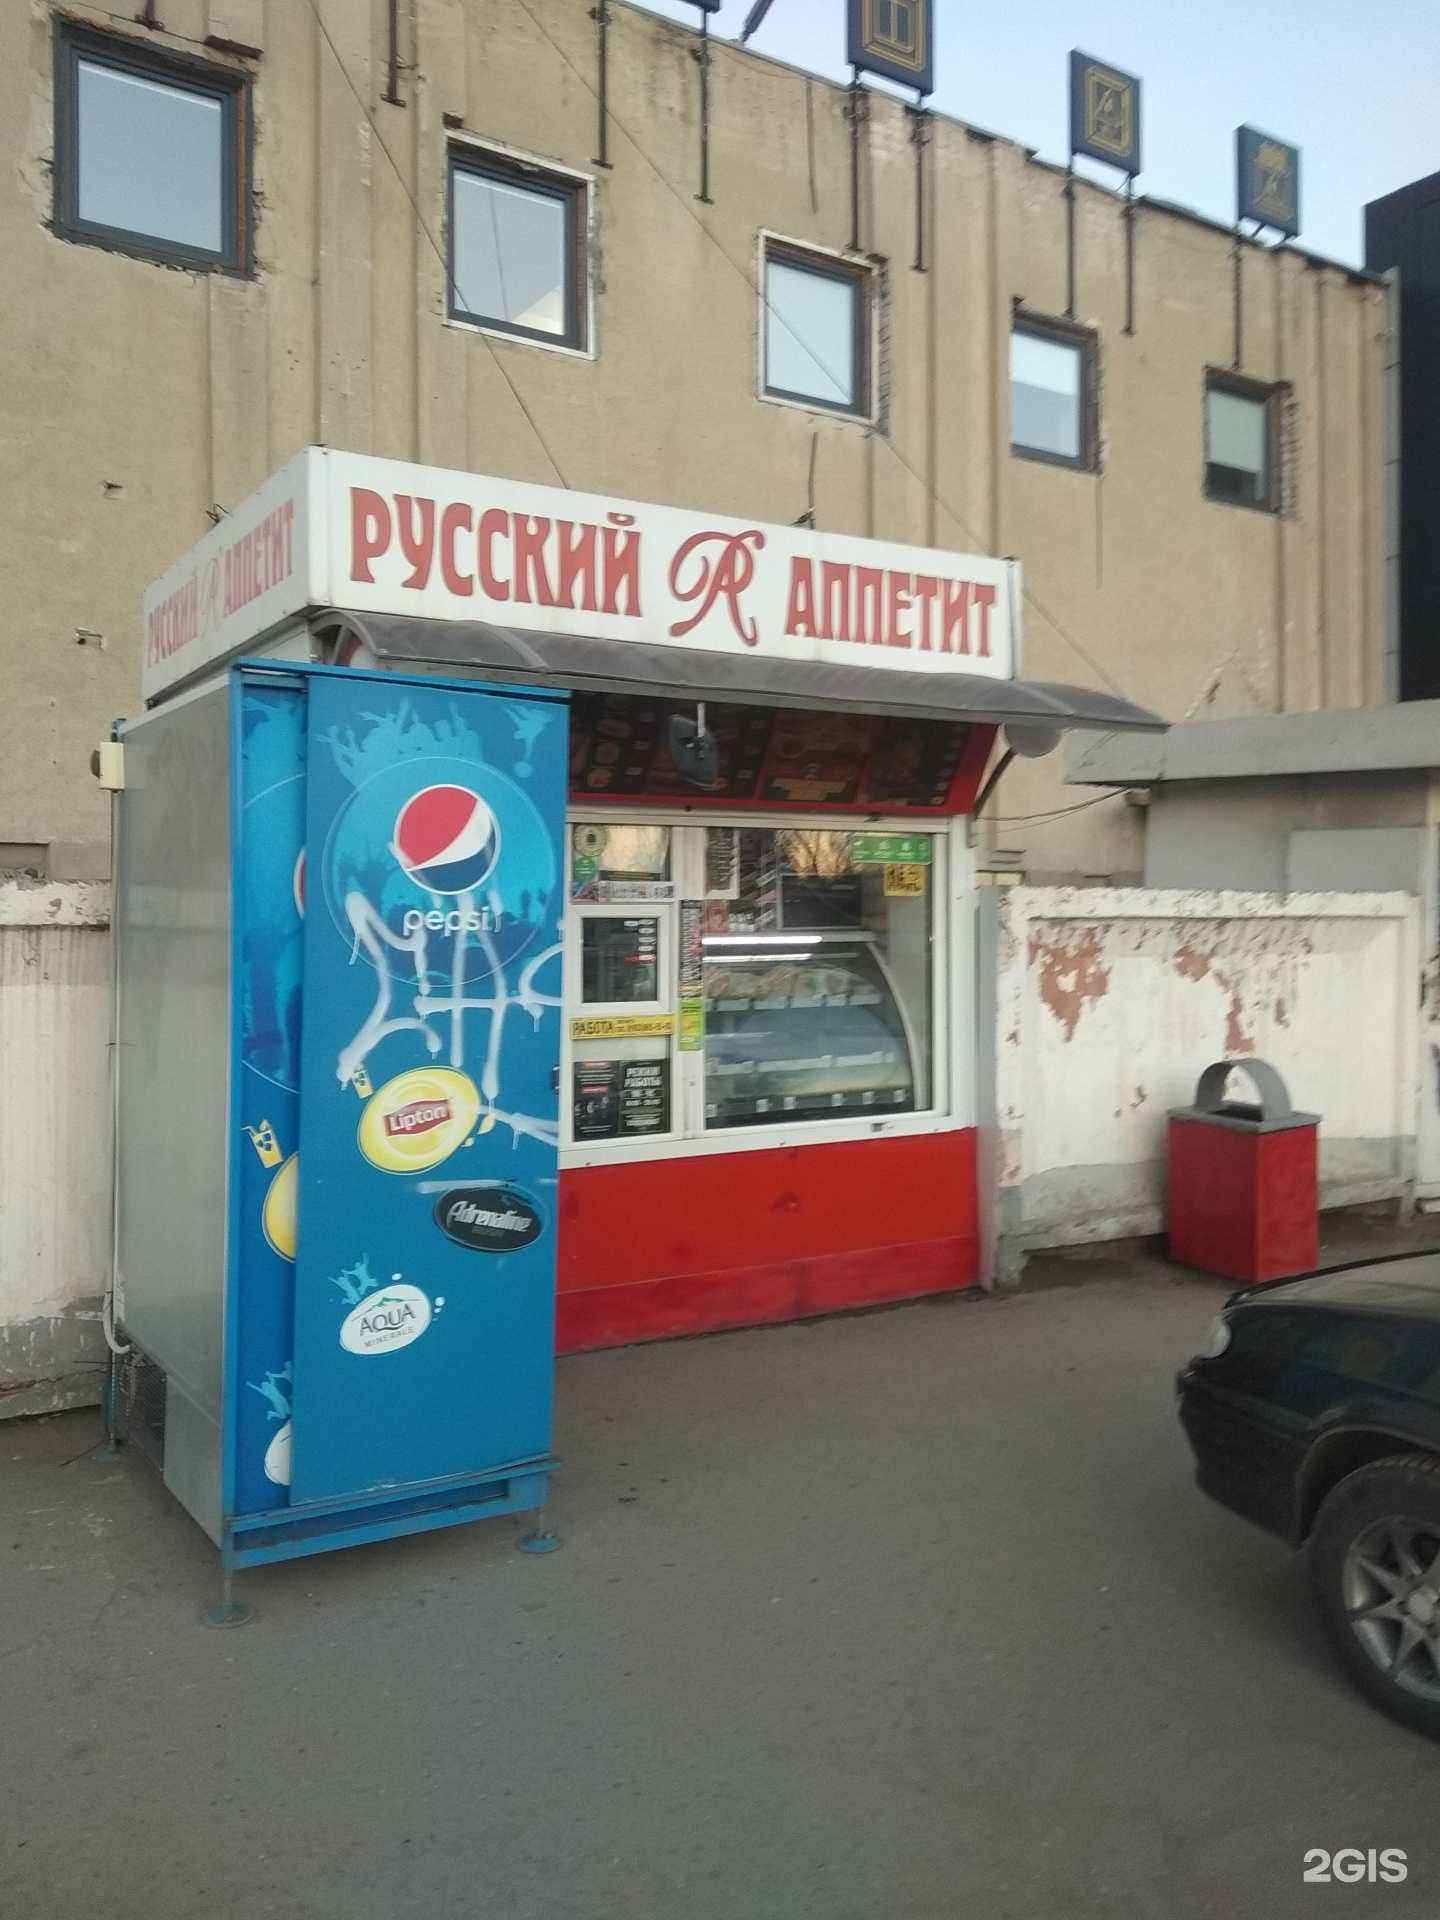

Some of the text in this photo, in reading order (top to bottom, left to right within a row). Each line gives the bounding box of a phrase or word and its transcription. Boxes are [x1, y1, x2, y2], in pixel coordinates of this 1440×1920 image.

[222, 498, 294, 619] АППЕТИТ
[349, 486, 643, 618] РУССКИЙ
[783, 555, 997, 658] АППЕТИТ
[402, 905, 491, 938] pepsi
[387, 1103, 450, 1135] Lipton
[446, 1200, 533, 1233] Adrenaline
[359, 1303, 416, 1337] AQUA
